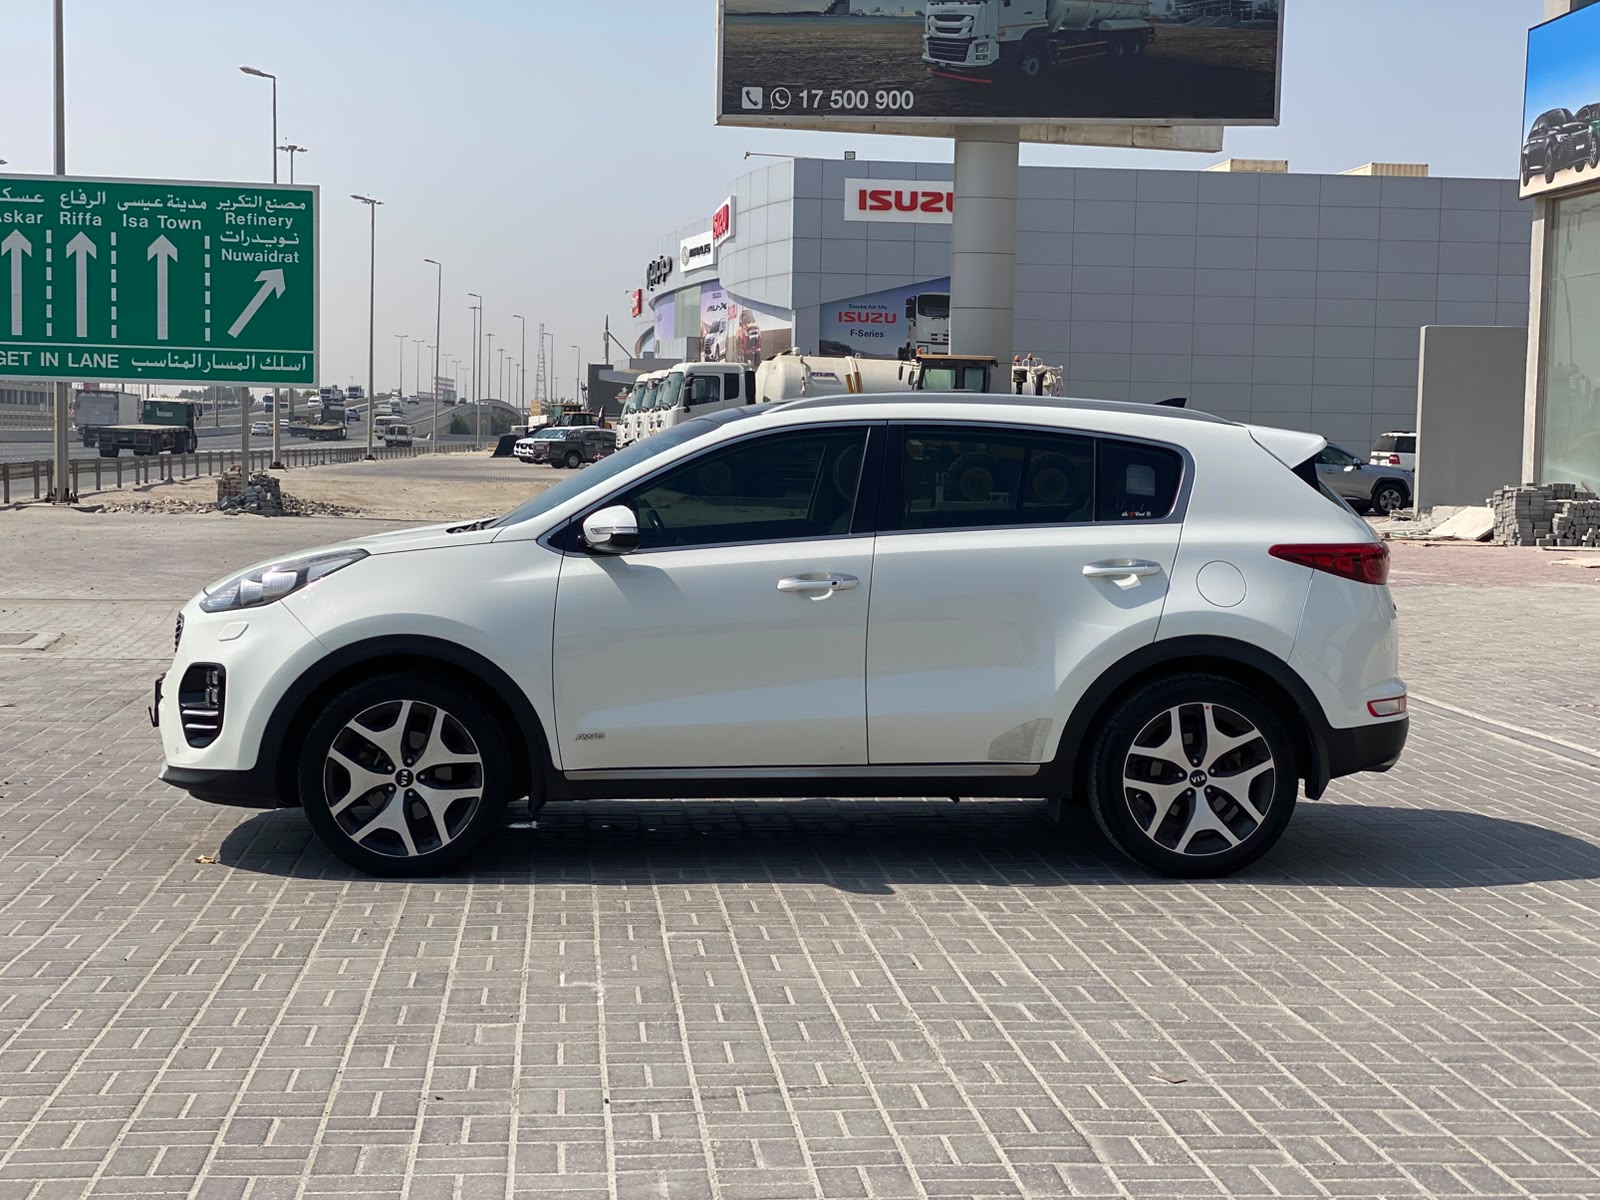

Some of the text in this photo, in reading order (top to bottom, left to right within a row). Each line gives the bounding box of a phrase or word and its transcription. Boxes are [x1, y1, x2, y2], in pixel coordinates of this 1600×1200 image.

[799, 89, 914, 110] 17 500 900
[0, 187, 45, 203] عسك
[60, 188, 106, 209] الرفاع
[117, 194, 207, 212] مدينة عيسى
[215, 194, 306, 212] مصنع التكرير
[0, 209, 44, 224] skar
[59, 211, 103, 226] Riffa
[122, 214, 202, 230] Isa Town
[225, 212, 293, 229] Refinery
[219, 229, 300, 247] نويدرات
[221, 249, 300, 264] Nuwaidrat
[838, 311, 897, 324] ISUZU
[850, 329, 885, 338] F-Series
[40, 352, 59, 367] IN
[68, 352, 119, 369] LANE
[131, 352, 307, 373] اسلك المسار المناسب
